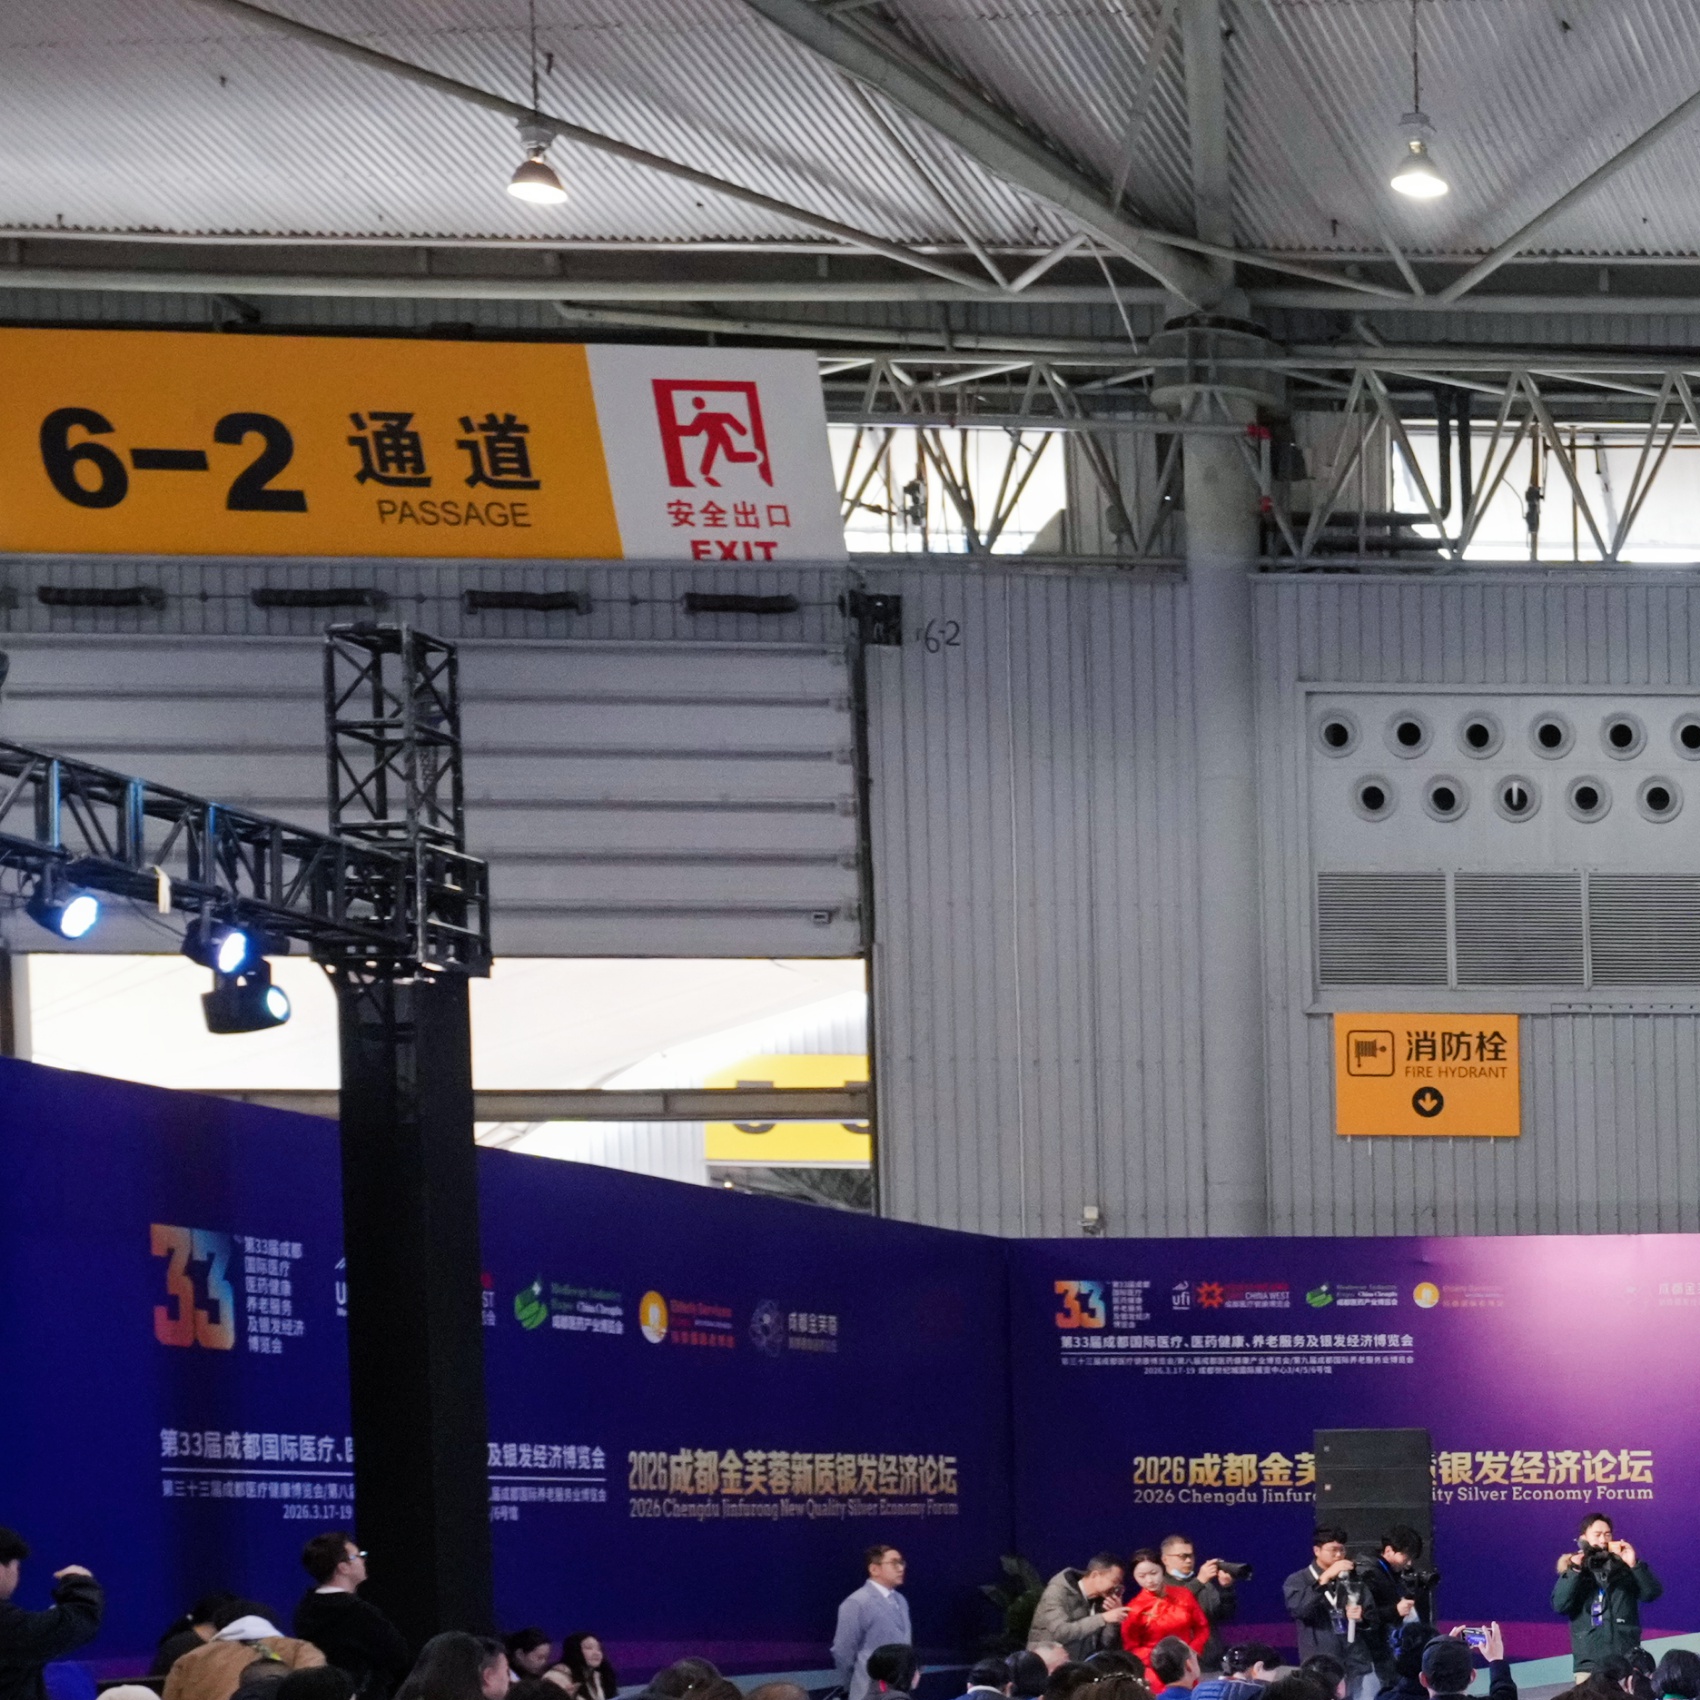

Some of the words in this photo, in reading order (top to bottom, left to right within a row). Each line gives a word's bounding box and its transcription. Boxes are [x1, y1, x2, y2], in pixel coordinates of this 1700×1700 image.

[39, 406, 309, 512] 6-2
[349, 411, 542, 490] 通道
[378, 499, 531, 529] PASSAGE
[666, 500, 792, 530] 安全出口
[692, 540, 778, 560] EXIT
[1406, 1030, 1508, 1062] 消防栓
[1405, 1066, 1433, 1078] FIRE
[1438, 1066, 1508, 1079] HYDRANT
[628, 1448, 957, 1496] 2026成都金芙蓉新质银发经济论坛
[1430, 1448, 1654, 1486] 银发经济论坛
[1133, 1489, 1175, 1504] 2026
[1178, 1488, 1258, 1506] Chengdu
[1457, 1486, 1508, 1501] Silver
[1512, 1486, 1592, 1503] Economy
[1596, 1485, 1654, 1500] Forum
[630, 1498, 661, 1518] 2026
[663, 1499, 720, 1521] Chengdu
[722, 1499, 779, 1521] Jinfurong
[780, 1499, 804, 1516] New
[806, 1499, 847, 1520] Quality
[848, 1499, 878, 1516] Silver
[879, 1499, 926, 1519] Economy
